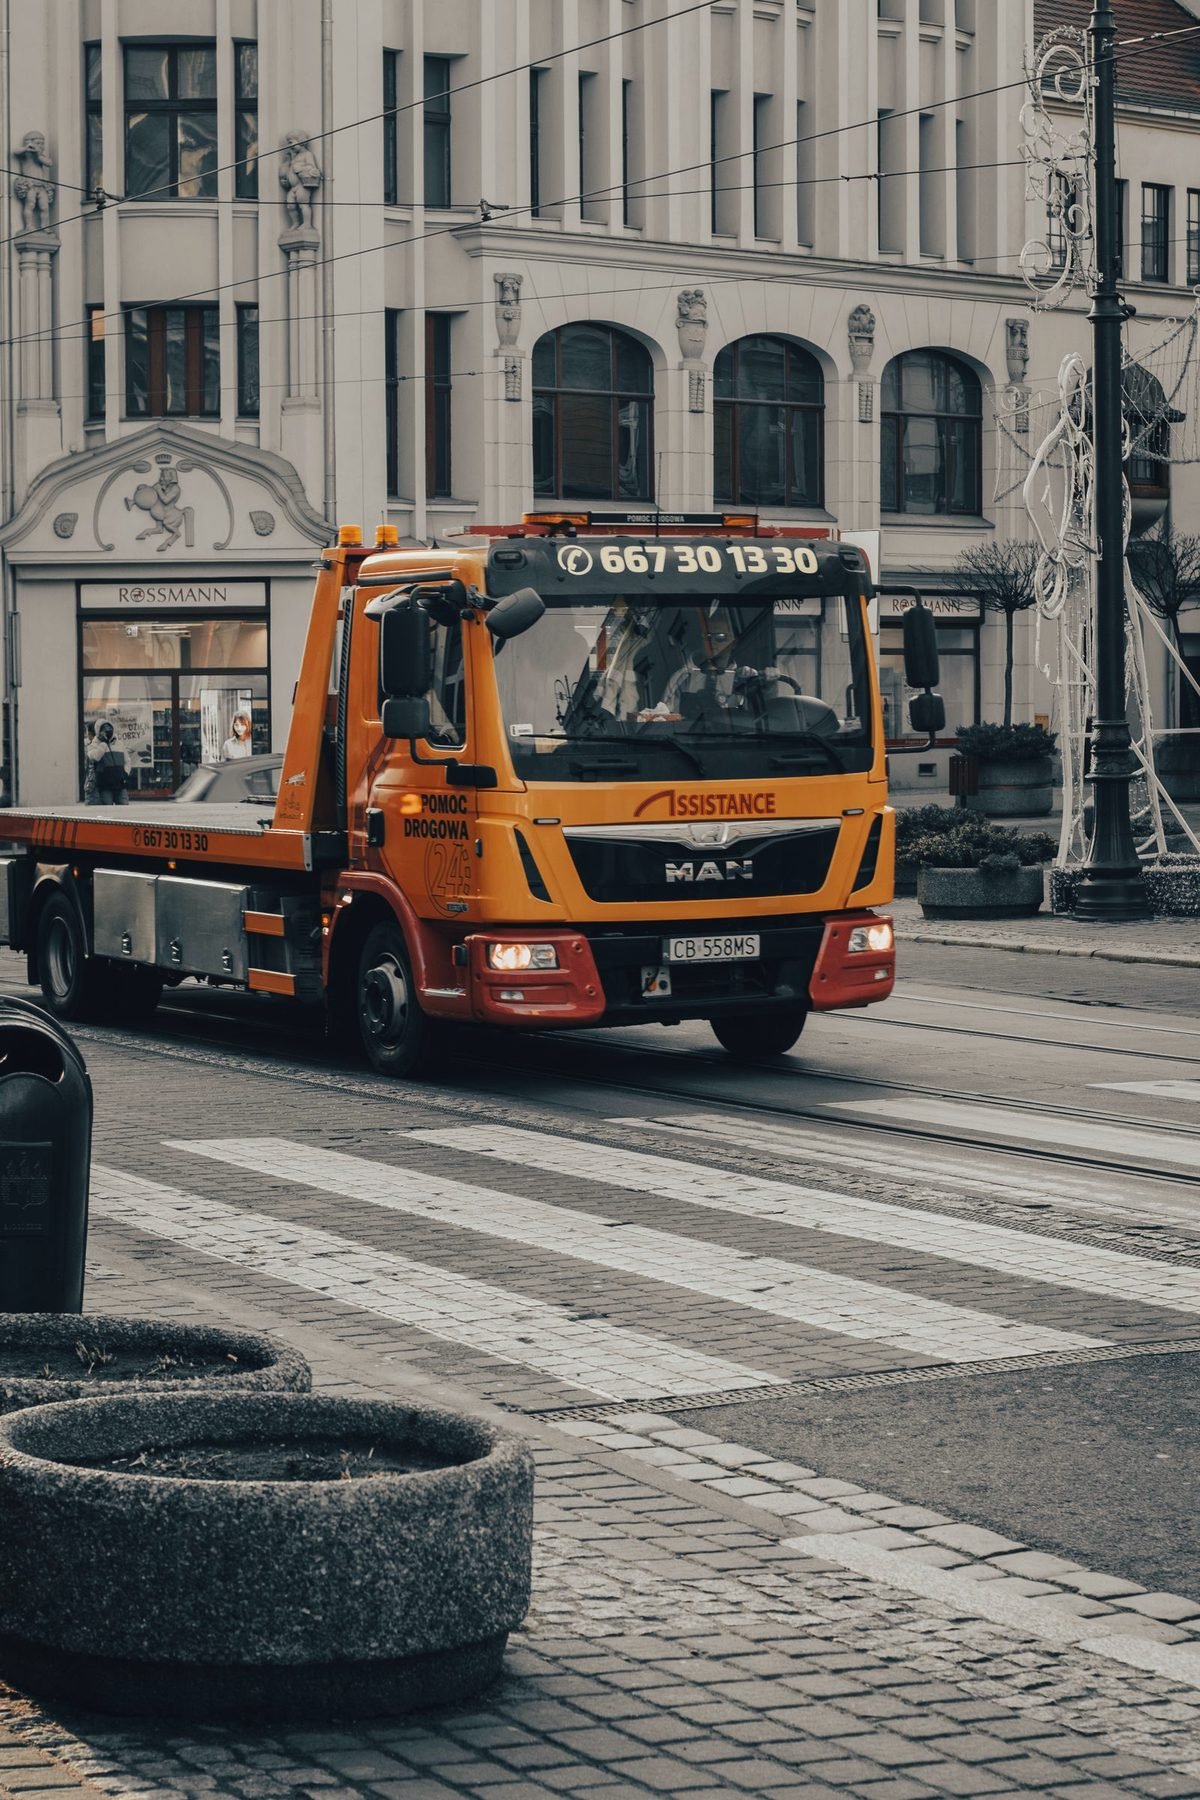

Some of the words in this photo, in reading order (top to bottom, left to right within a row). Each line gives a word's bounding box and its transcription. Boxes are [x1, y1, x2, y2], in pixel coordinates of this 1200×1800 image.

[600, 546, 666, 573] 667
[677, 546, 722, 573] 30
[726, 546, 768, 573] 13
[776, 547, 819, 574] 30
[119, 587, 227, 602] ROSSMANN
[892, 599, 960, 613] ROSMANN
[421, 794, 467, 814] POMOC
[633, 789, 776, 817] ASSISTANCE
[144, 829, 161, 847] 667
[164, 831, 178, 848] 30
[180, 832, 191, 850] 13
[194, 833, 208, 851] 30
[404, 818, 469, 840] DROGOWA
[664, 860, 753, 882] MAN
[674, 940, 696, 958] CB
[704, 937, 755, 957] 558MS
